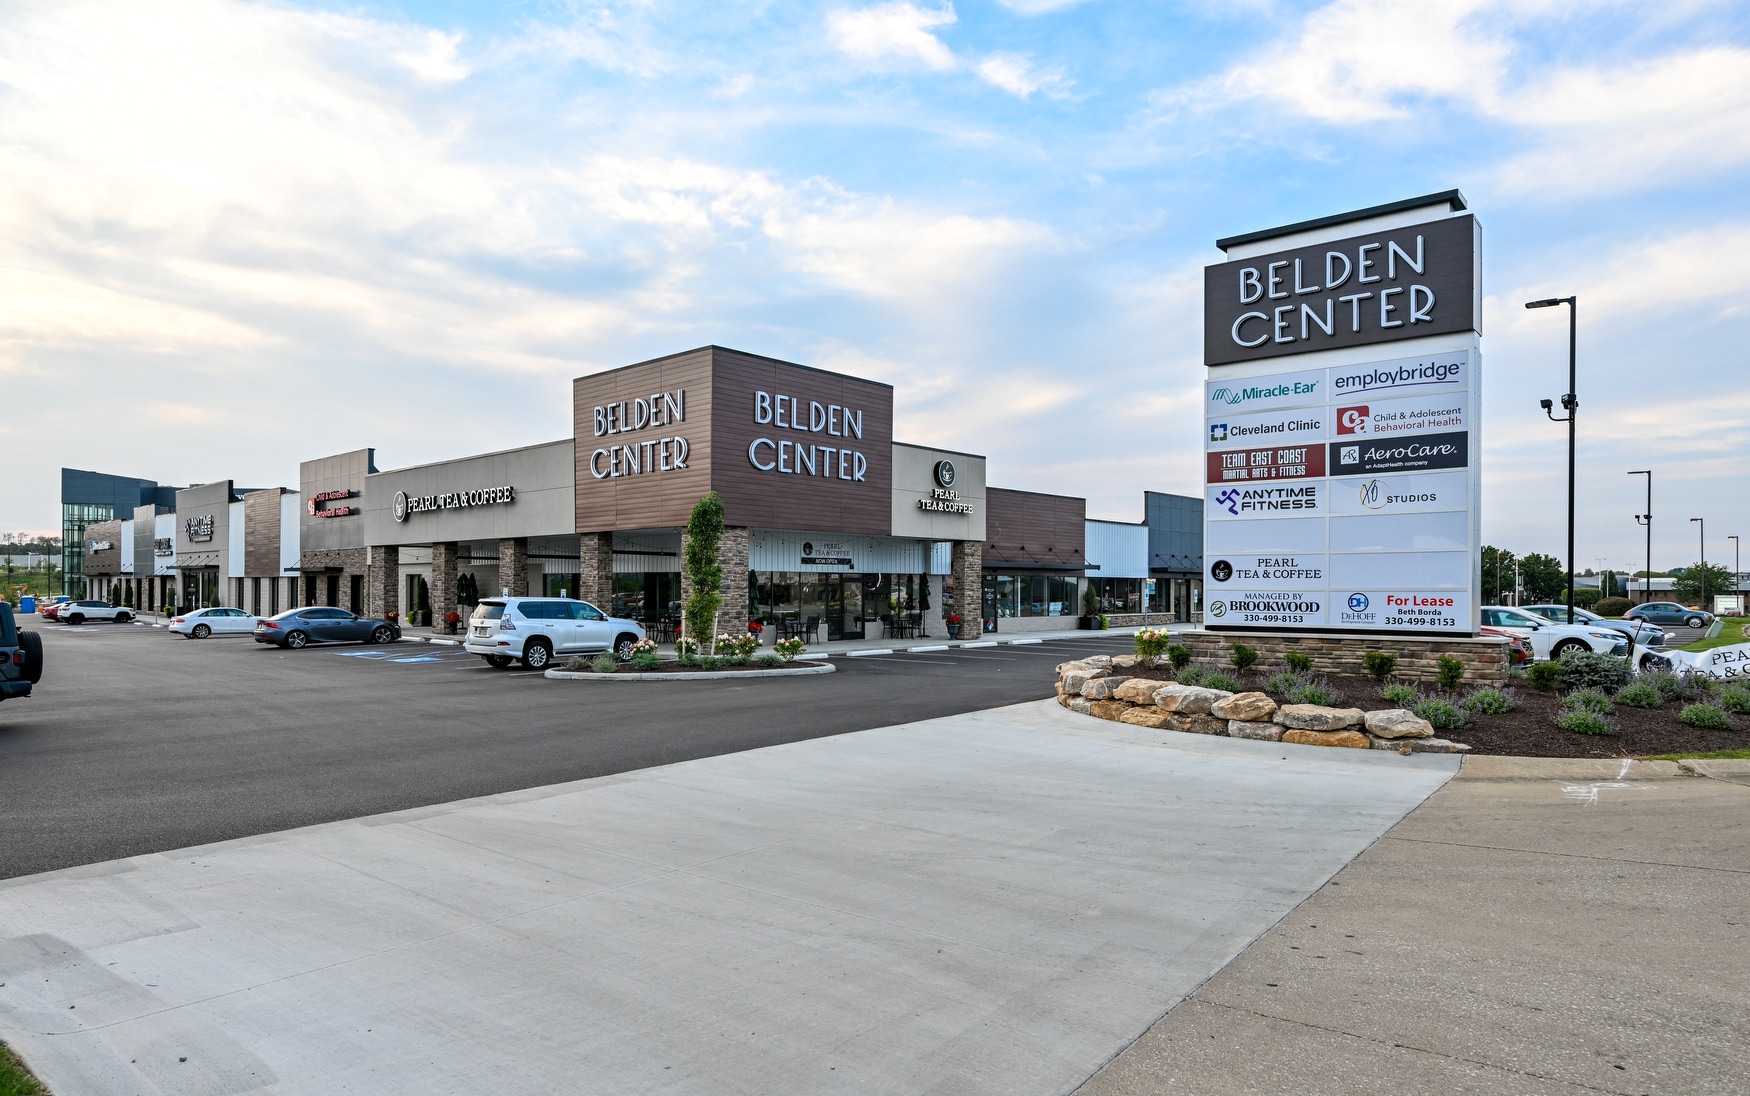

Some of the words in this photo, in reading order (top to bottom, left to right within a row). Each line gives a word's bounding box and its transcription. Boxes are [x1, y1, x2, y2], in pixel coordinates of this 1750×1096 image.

[1239, 234, 1425, 305] BELDEN
[1231, 284, 1437, 348] CENTER
[1335, 361, 1460, 390] employbridge
[593, 388, 685, 437] BELDEN
[754, 390, 862, 440] BELDEN
[1374, 412, 1398, 423] Child
[1400, 411, 1406, 420] &
[1409, 407, 1462, 419] Adolescent
[1230, 422, 1285, 437] Cleveland
[1287, 419, 1321, 433] Clinic
[1374, 420, 1426, 433] Behavioral
[1428, 416, 1462, 428] Health
[589, 436, 689, 479] CENTER
[747, 437, 867, 482] CENTER
[1222, 452, 1246, 468] TEAM
[1251, 451, 1273, 466] EAST
[1278, 448, 1307, 464] COAST
[1364, 444, 1455, 461] AeroCare
[1222, 467, 1249, 480] MARTIAL
[1251, 467, 1268, 479] ARTS
[1271, 467, 1276, 477] &
[1279, 465, 1306, 476] FITNESS
[1372, 461, 1403, 470] AdaptHealth
[1404, 460, 1429, 468] company
[407, 496, 438, 513] PEARL
[440, 493, 460, 509] TEA
[461, 492, 468, 507] &
[469, 486, 512, 506] COFFEE
[934, 488, 961, 501] PEARL
[1241, 487, 1316, 499] ANYTIME
[1387, 493, 1437, 504] STUDIOS
[921, 499, 937, 511] TEA
[937, 501, 944, 511] &
[944, 501, 974, 514] COFFEE
[1241, 498, 1318, 511] FITNESS
[1257, 558, 1298, 568] PEARL
[1236, 569, 1260, 579] TEA
[1262, 570, 1271, 579] &
[1273, 569, 1321, 579] COFFEE
[1229, 601, 1320, 613] BROOKWOOD
[1387, 595, 1410, 607] For
[1413, 595, 1454, 607] Lease
[1244, 614, 1304, 623] 330-499-8153
[1397, 608, 1416, 616] Beth
[1418, 608, 1442, 616] Borda
[1385, 617, 1455, 626] 330-499-8153
[1725, 667, 1738, 678] &
